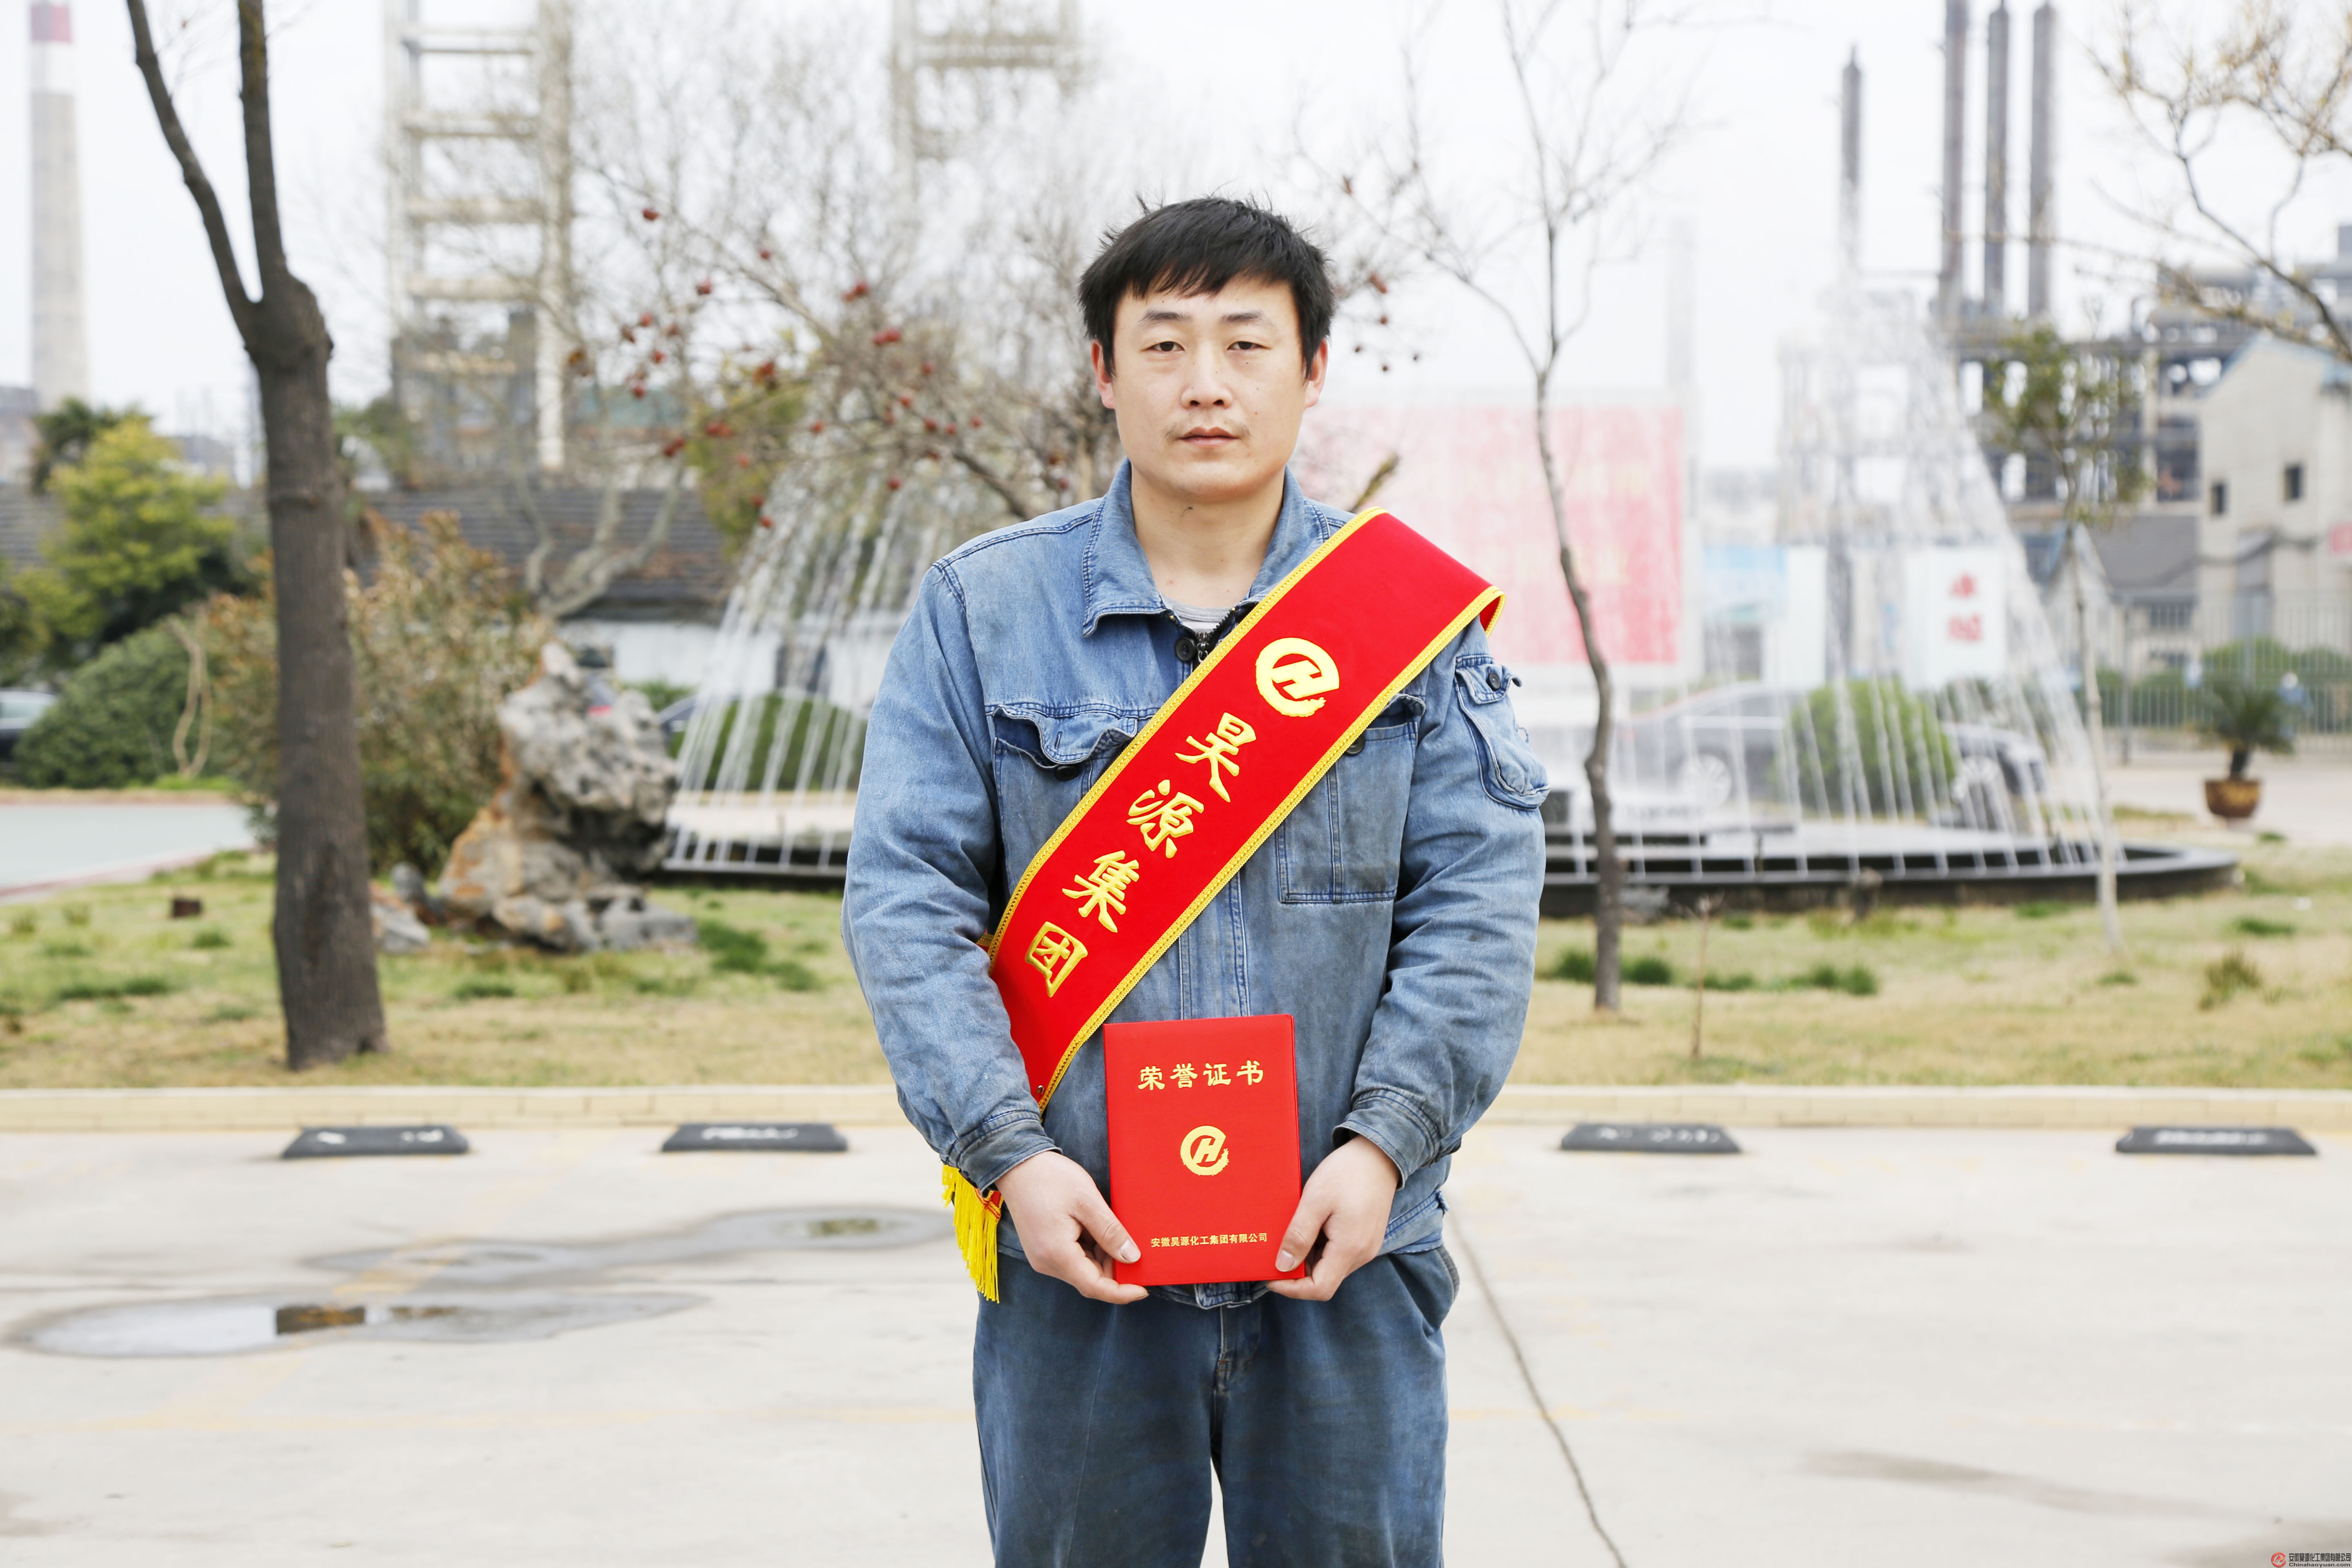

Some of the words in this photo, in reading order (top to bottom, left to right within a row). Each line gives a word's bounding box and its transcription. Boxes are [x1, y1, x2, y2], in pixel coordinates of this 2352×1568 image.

[1025, 712, 1257, 998] 昊源集团
[1137, 1060, 1264, 1091] 荣誉证书
[1151, 1232, 1268, 1248] 安徽昊源化工集团有限公司
